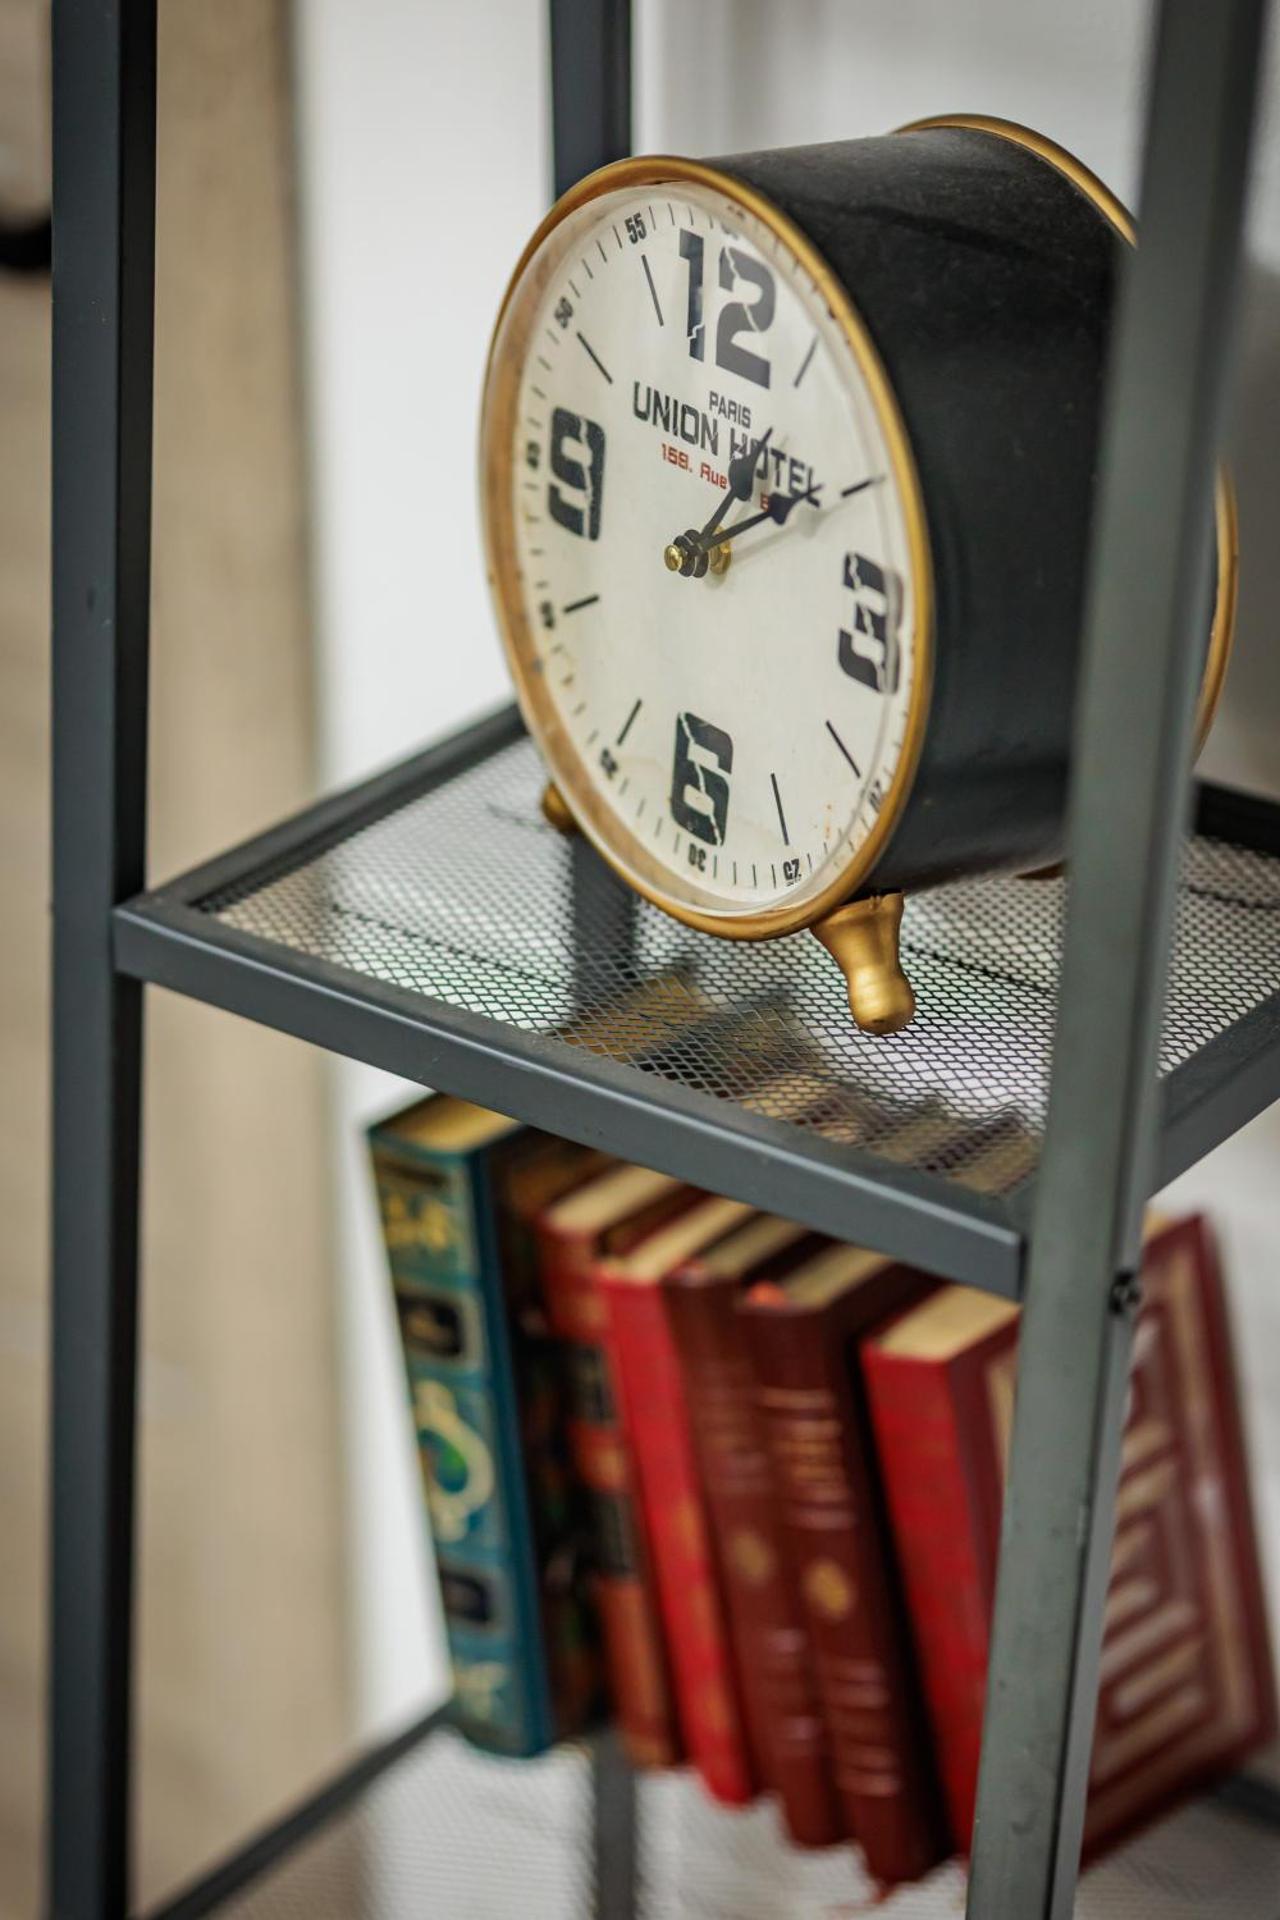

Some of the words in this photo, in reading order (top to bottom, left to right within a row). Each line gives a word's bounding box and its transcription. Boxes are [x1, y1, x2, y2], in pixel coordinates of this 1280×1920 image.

[625, 212, 648, 244] 55
[678, 229, 777, 390] 12
[633, 381, 719, 457] UNION
[729, 428, 821, 508] HOTEL
[709, 391, 751, 428] PARIS
[548, 407, 606, 541] 9
[700, 462, 729, 490] Rue
[837, 552, 903, 696] 3
[670, 712, 734, 847] 6
[688, 843, 707, 876] 30
